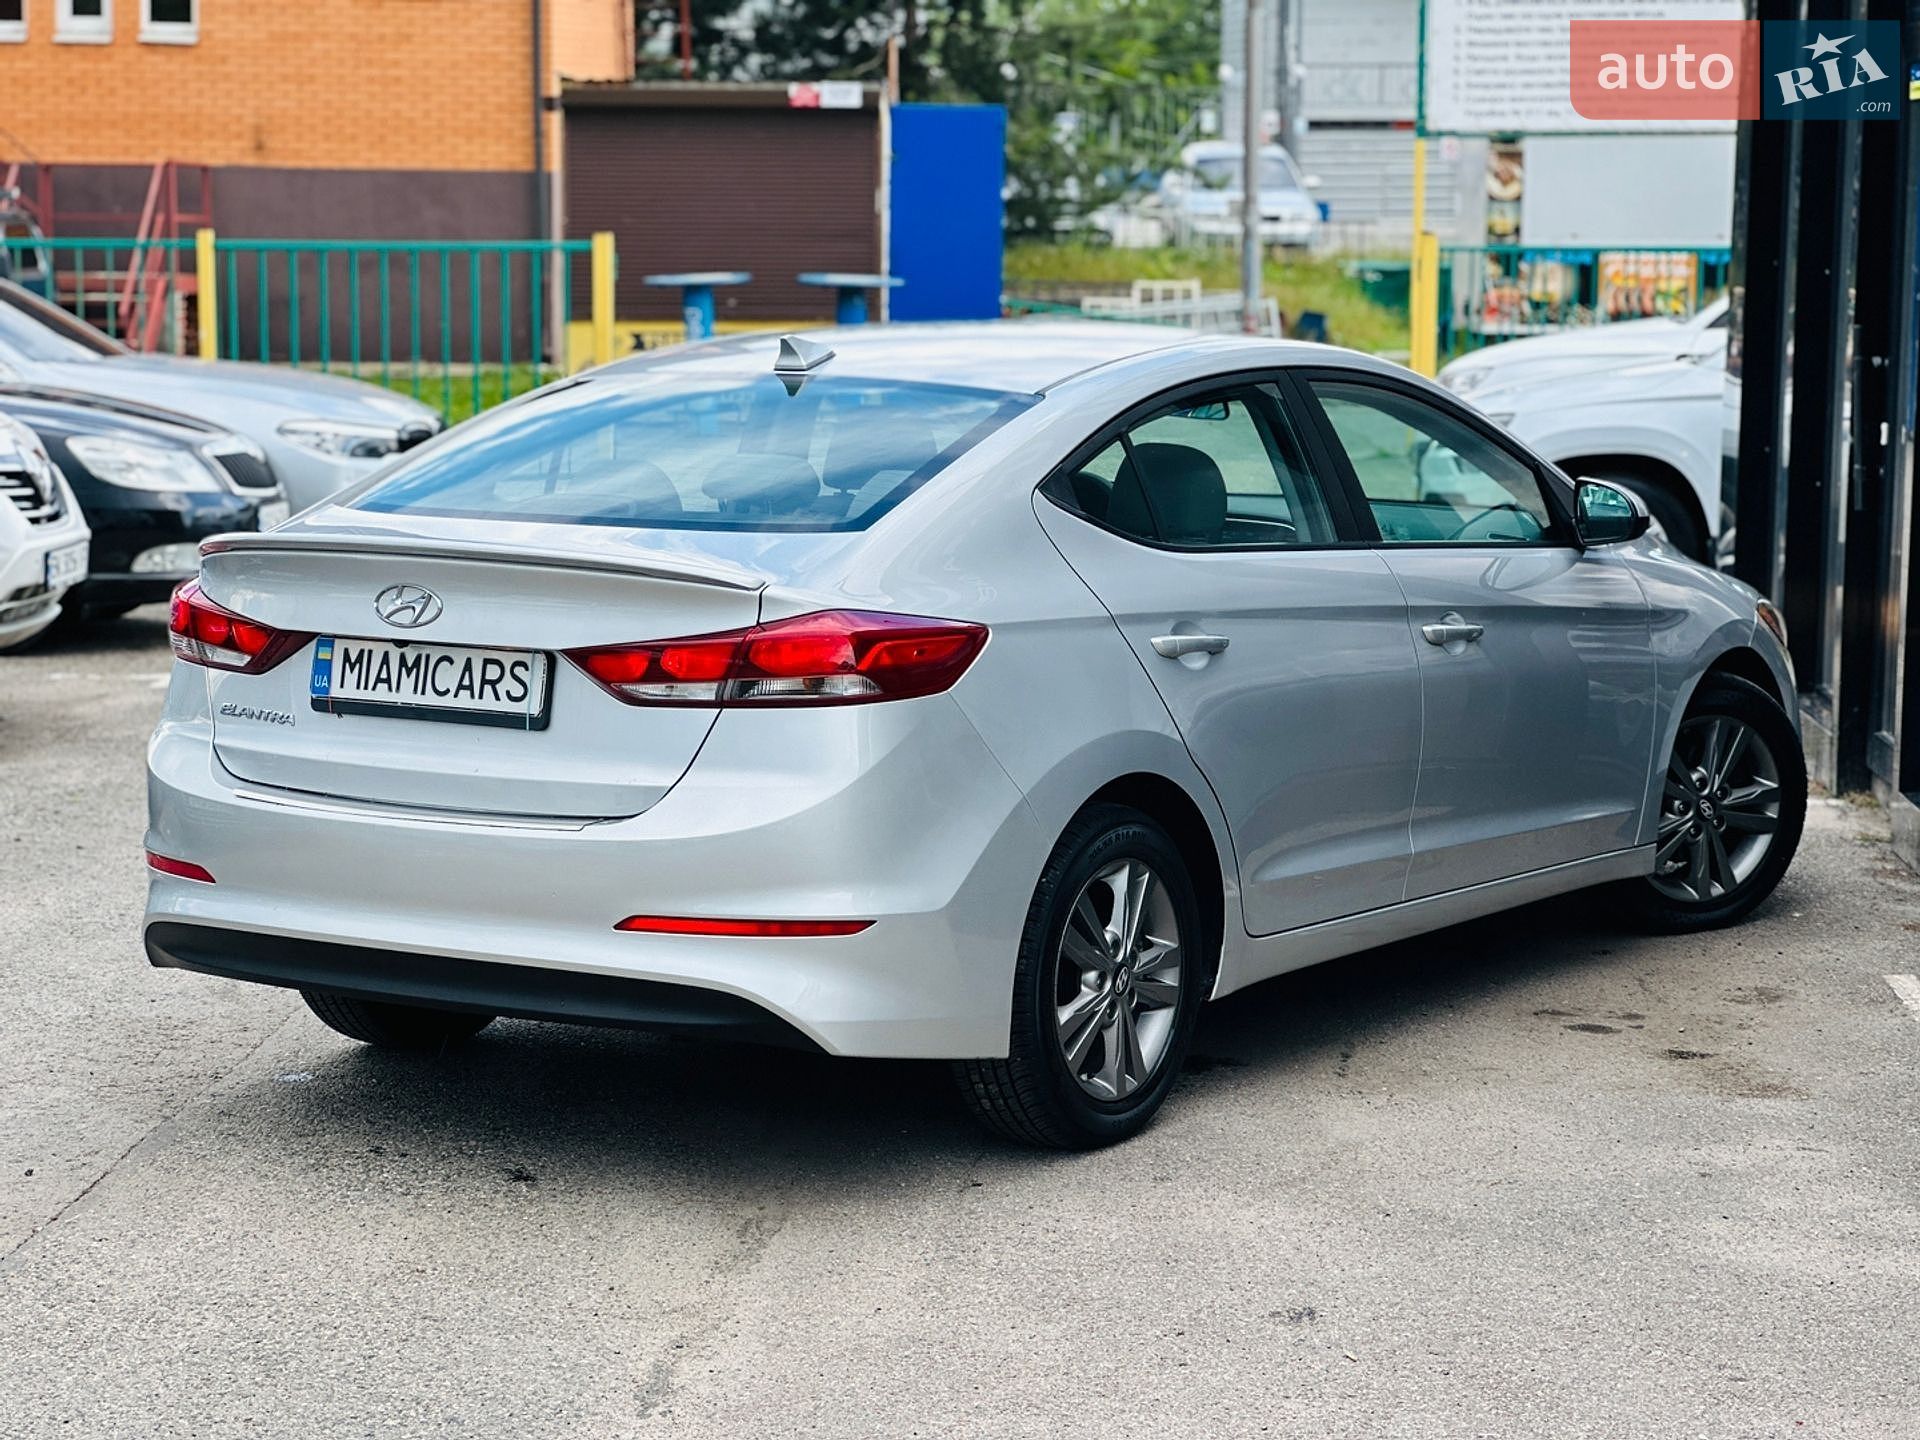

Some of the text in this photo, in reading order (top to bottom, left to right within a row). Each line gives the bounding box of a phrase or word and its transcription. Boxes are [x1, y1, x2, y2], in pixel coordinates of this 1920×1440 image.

[314, 674, 329, 688] UA
[340, 647, 529, 702] MIAMICARS
[220, 703, 296, 727] ELANTRA
